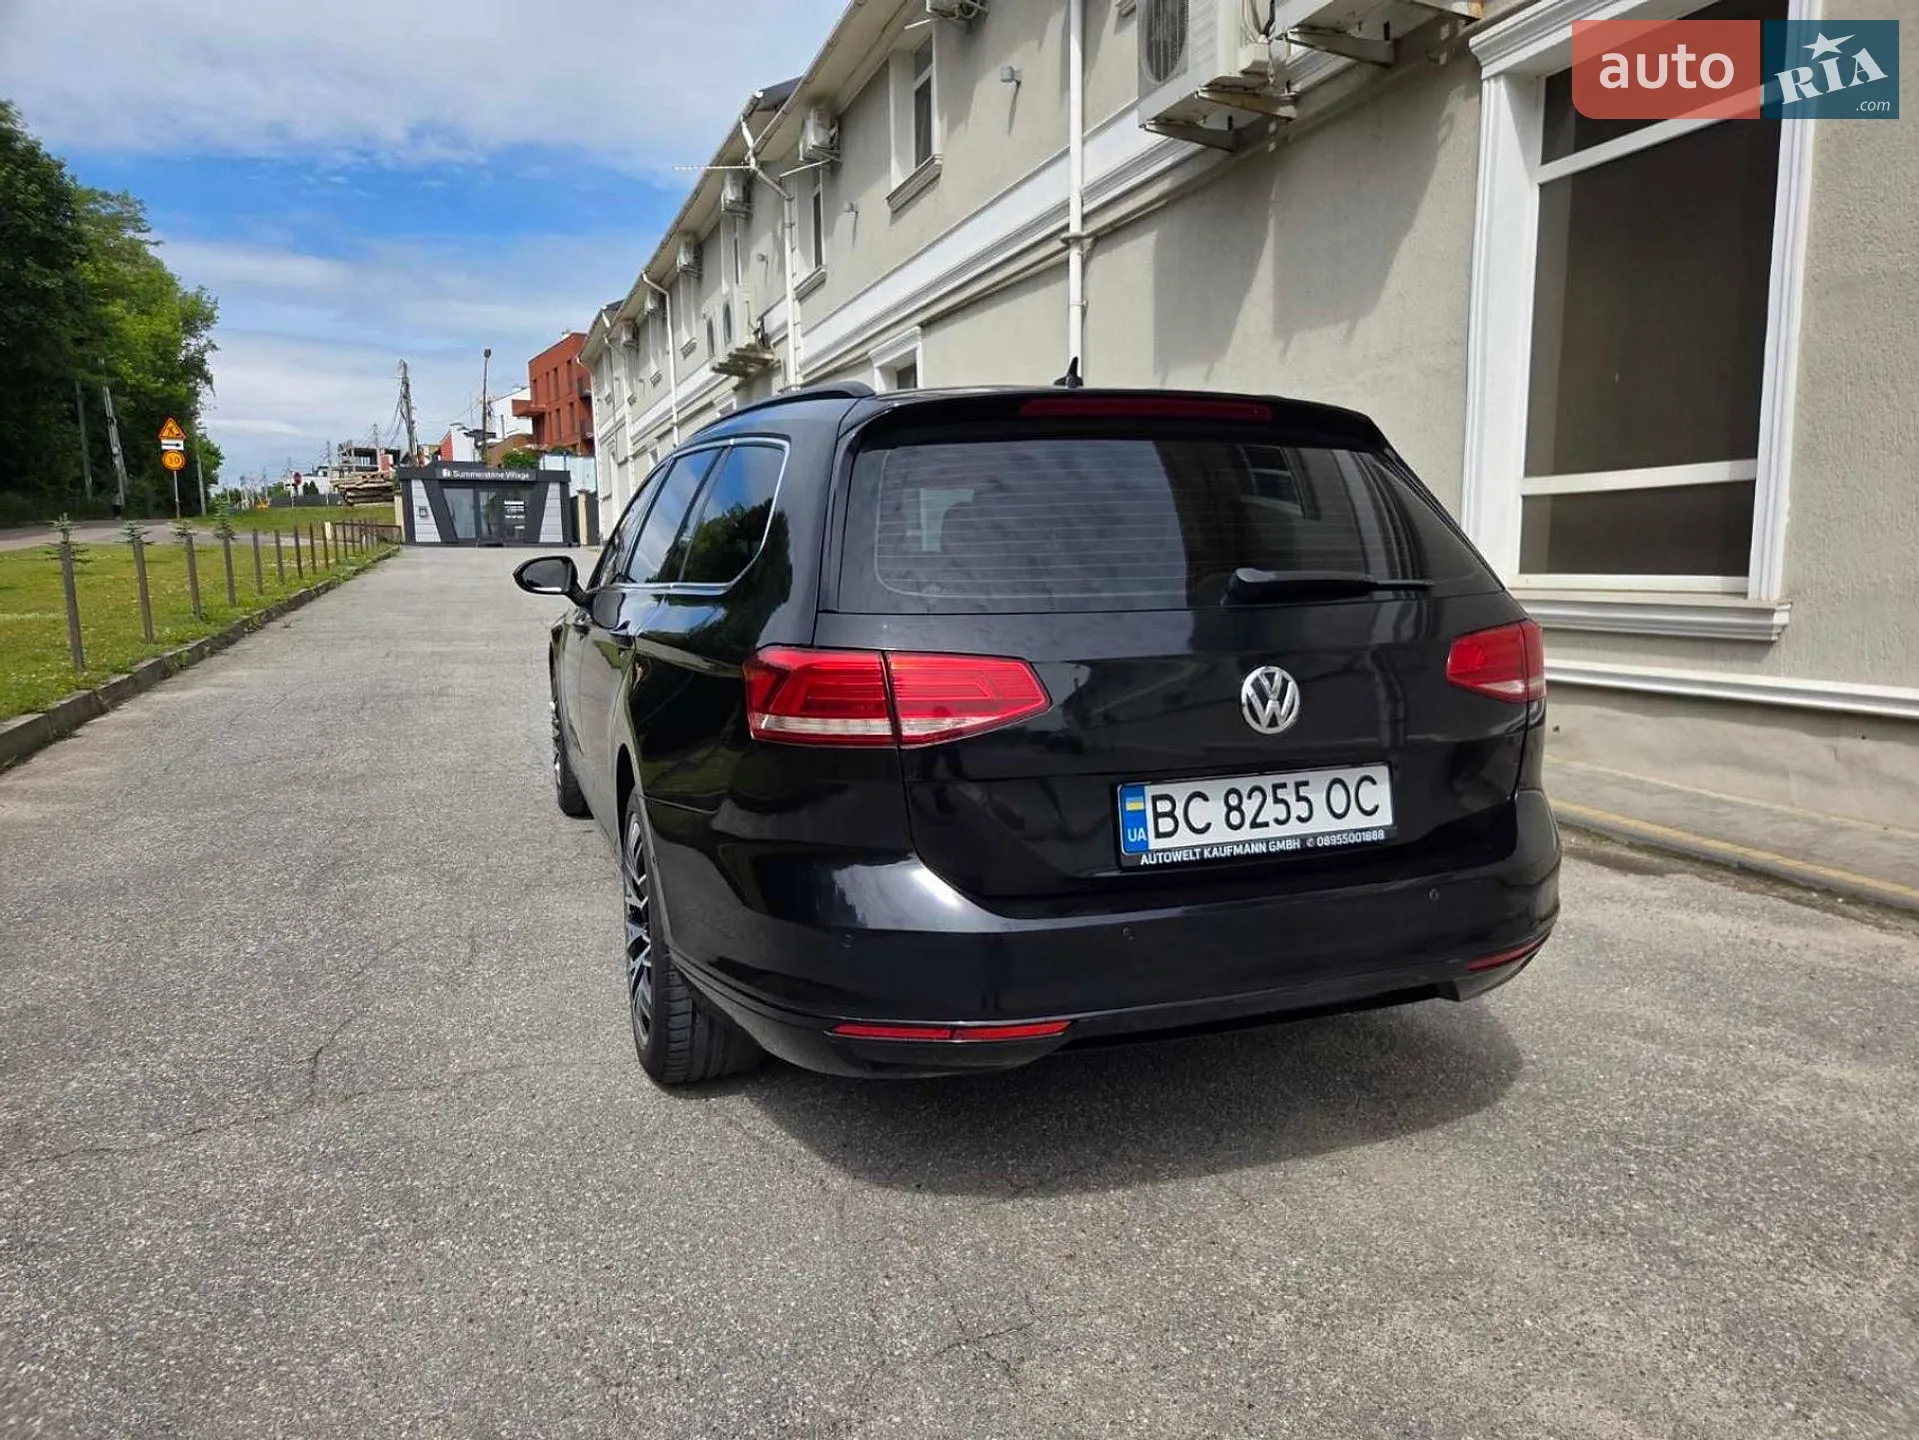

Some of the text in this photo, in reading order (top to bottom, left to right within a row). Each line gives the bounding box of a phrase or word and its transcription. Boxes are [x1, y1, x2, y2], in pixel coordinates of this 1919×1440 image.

[1150, 775, 1380, 839] BC 8255 OC
[1127, 828, 1147, 842] UA
[1140, 847, 1202, 865] AUTOWELT
[1203, 841, 1267, 859] KAUFMANN
[1268, 838, 1301, 852] GMBH
